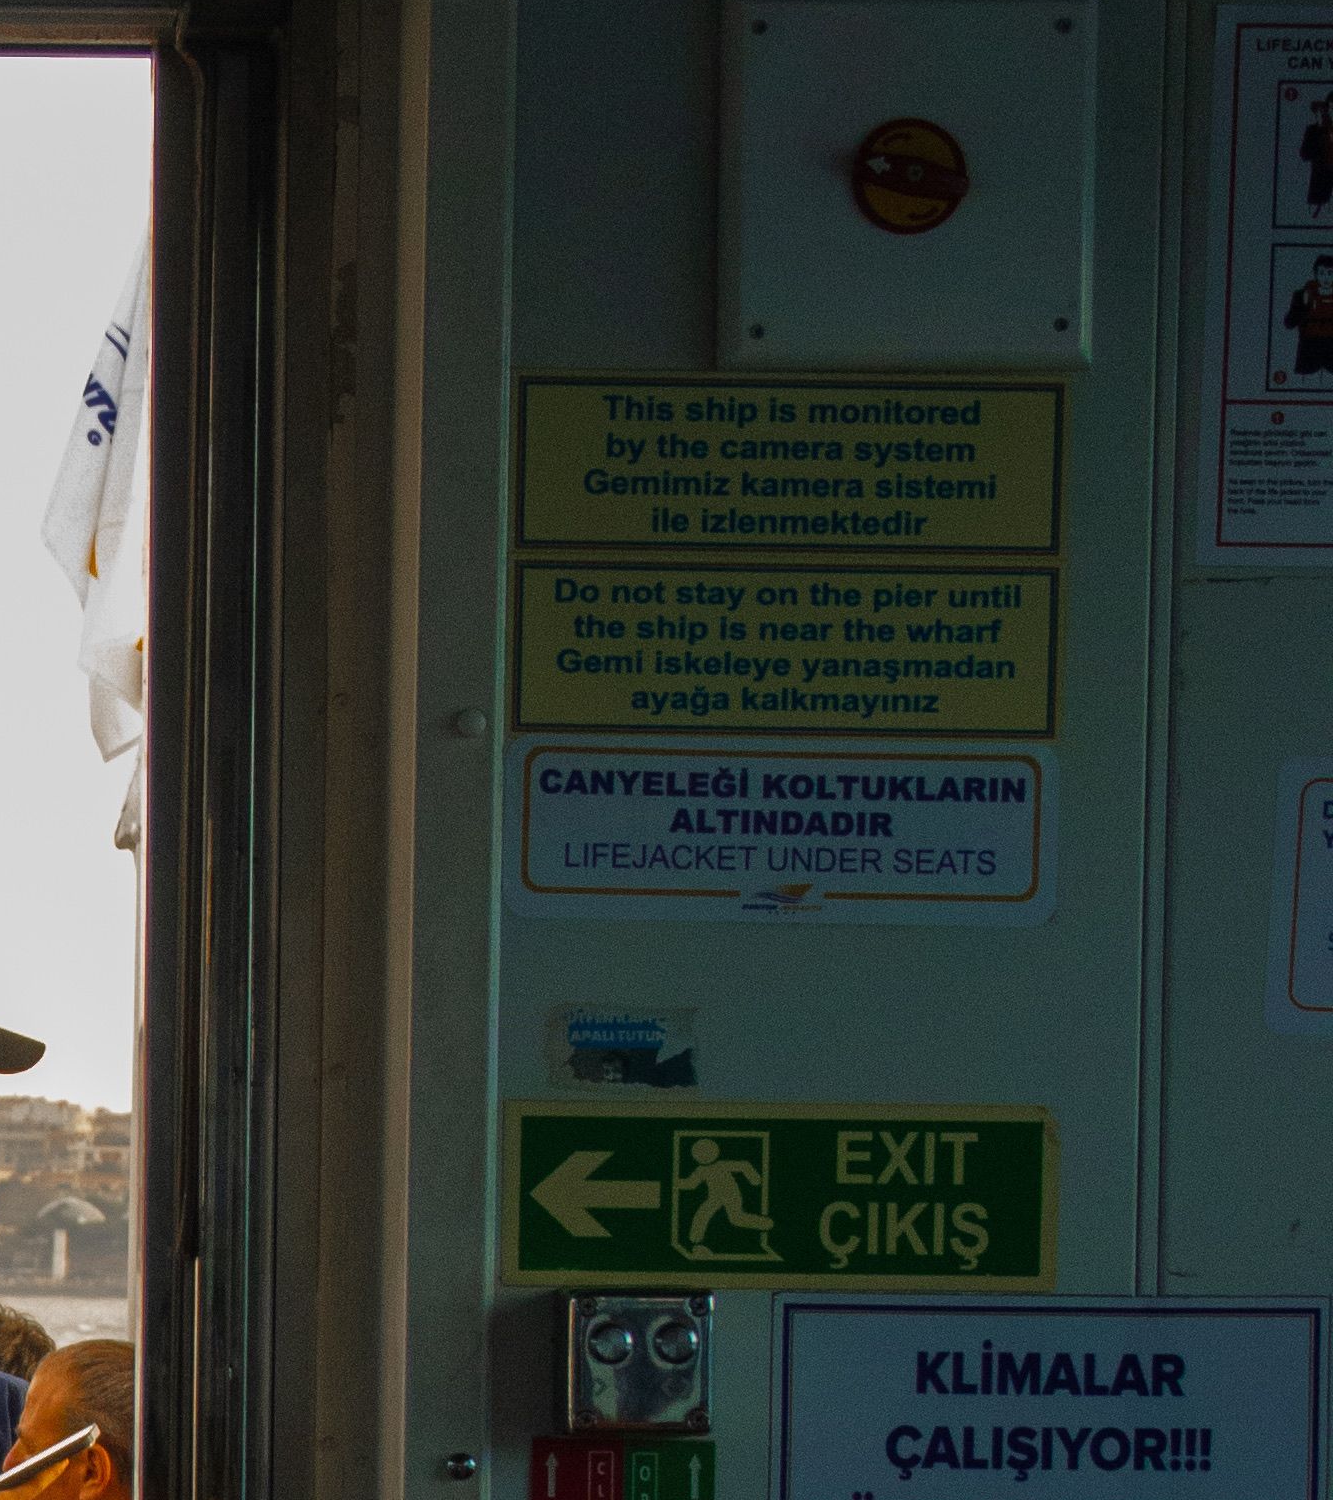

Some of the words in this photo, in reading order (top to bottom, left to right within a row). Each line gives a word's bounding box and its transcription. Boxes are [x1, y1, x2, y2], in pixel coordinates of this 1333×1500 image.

[604, 395, 676, 425] This
[685, 397, 759, 429] ship
[769, 397, 797, 425] is
[807, 398, 981, 427] monitored
[606, 434, 645, 469] by
[657, 434, 709, 463] the
[719, 437, 844, 463] camera
[853, 437, 976, 466] system
[584, 470, 731, 500] Gemimiz
[741, 471, 863, 500] kamera
[874, 476, 995, 501] sistemi
[651, 509, 690, 536] ile
[700, 509, 928, 538] izlenmektedir
[554, 578, 599, 604] Do
[612, 580, 665, 606] not
[676, 581, 742, 611] stay
[755, 584, 801, 608] on
[811, 581, 859, 609] the
[873, 584, 937, 615] pier
[948, 584, 1021, 610] until
[574, 615, 624, 642] the
[635, 616, 709, 648] ship
[720, 616, 747, 643] is
[757, 618, 832, 643] near
[844, 618, 894, 644] the
[905, 618, 1001, 646] wharf
[557, 652, 644, 675] Gemi
[654, 652, 790, 683] iskeleye
[801, 655, 1016, 685] yanaşmadan
[631, 689, 730, 716] ayağa
[740, 689, 939, 717] kalkmayınız
[540, 768, 747, 799] CANYELEĞİ
[763, 775, 1027, 802] KOLTUKLARIN
[671, 809, 893, 837] ALTINDADIR
[564, 844, 756, 872] LIFEJACKET
[767, 847, 883, 874] UNDER
[894, 848, 996, 877] SEATS
[835, 1131, 979, 1186] EXIT
[819, 1202, 989, 1270] ÇIKIŞ
[915, 1339, 1185, 1399] KLİMALAR
[887, 1427, 1211, 1481] ÇALIŞIYOR!!!
